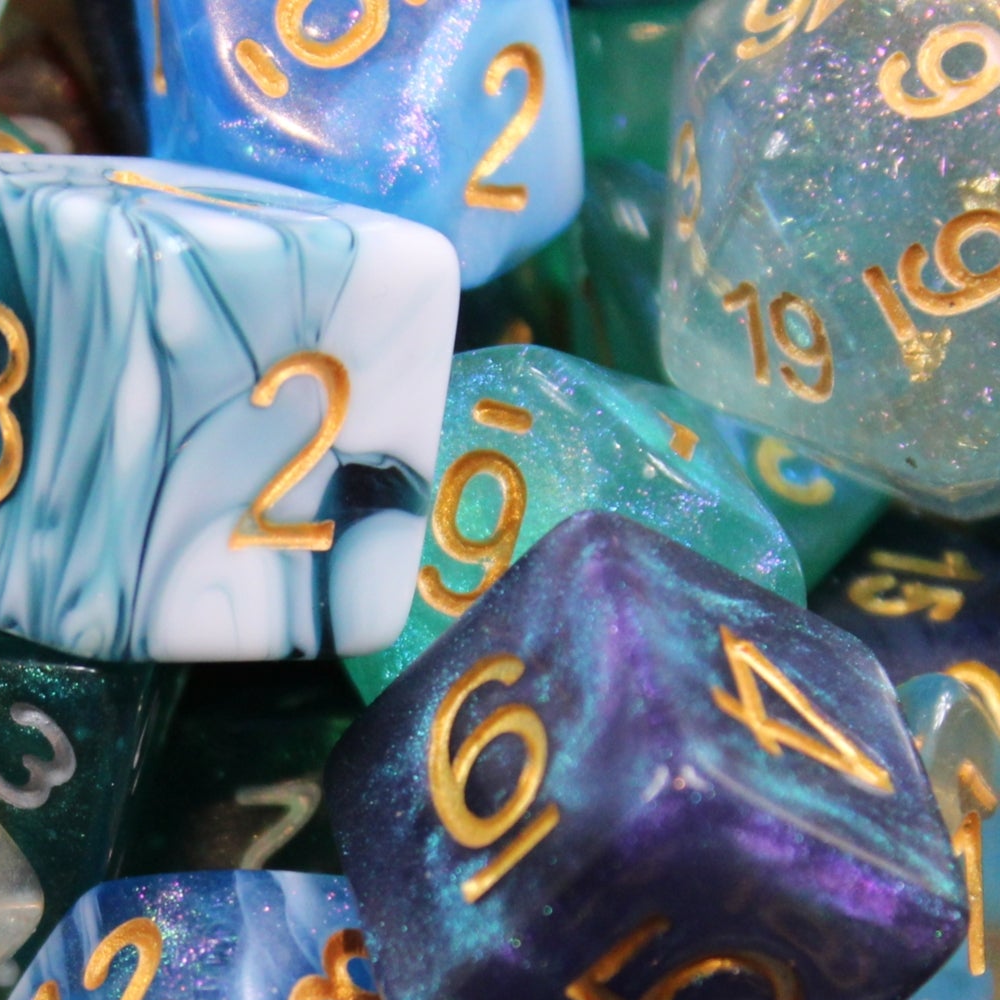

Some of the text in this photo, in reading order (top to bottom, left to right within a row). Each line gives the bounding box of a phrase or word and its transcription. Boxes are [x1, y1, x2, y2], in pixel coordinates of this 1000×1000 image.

[465, 43, 545, 212] 2
[722, 279, 835, 404] 19
[229, 351, 350, 553] 2
[428, 655, 562, 905] 6
[711, 625, 896, 796] 4
